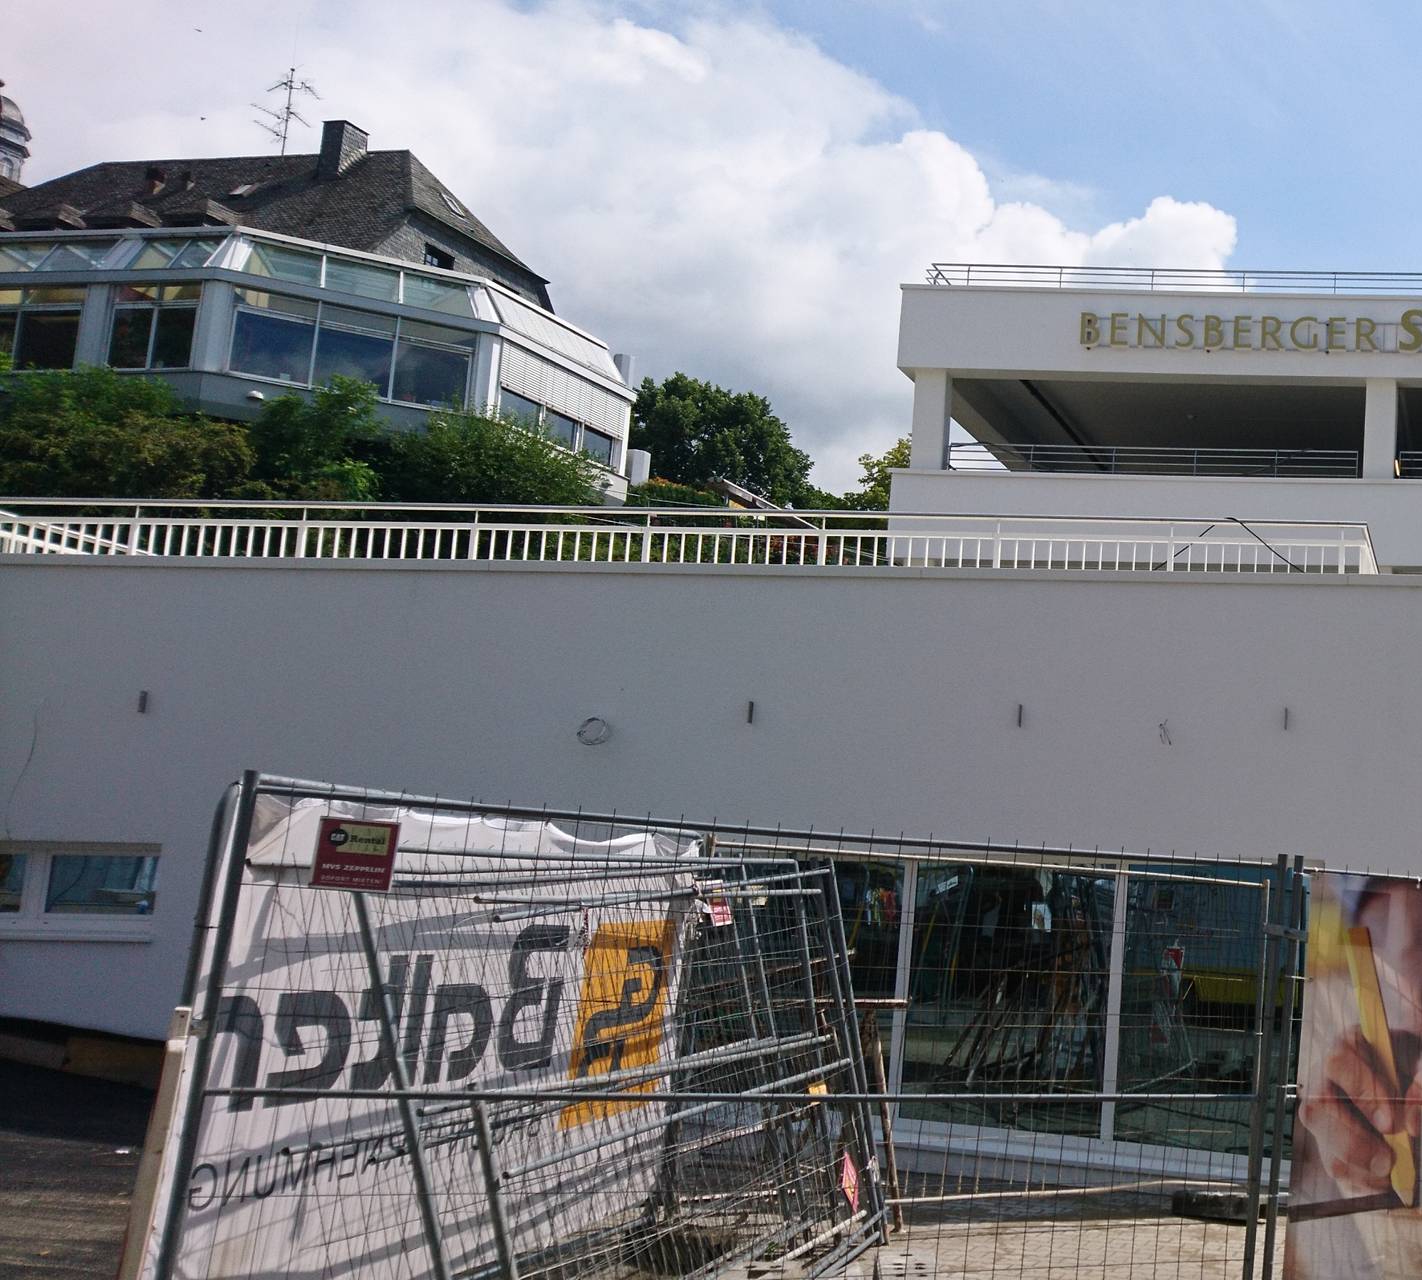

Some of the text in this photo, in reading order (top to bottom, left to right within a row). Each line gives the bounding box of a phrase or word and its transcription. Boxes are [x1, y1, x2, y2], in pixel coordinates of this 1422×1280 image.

[1079, 311, 1378, 351] BENSBERGER
[350, 834, 385, 845] Rental
[321, 863, 386, 873] MVS ZEPPELIN
